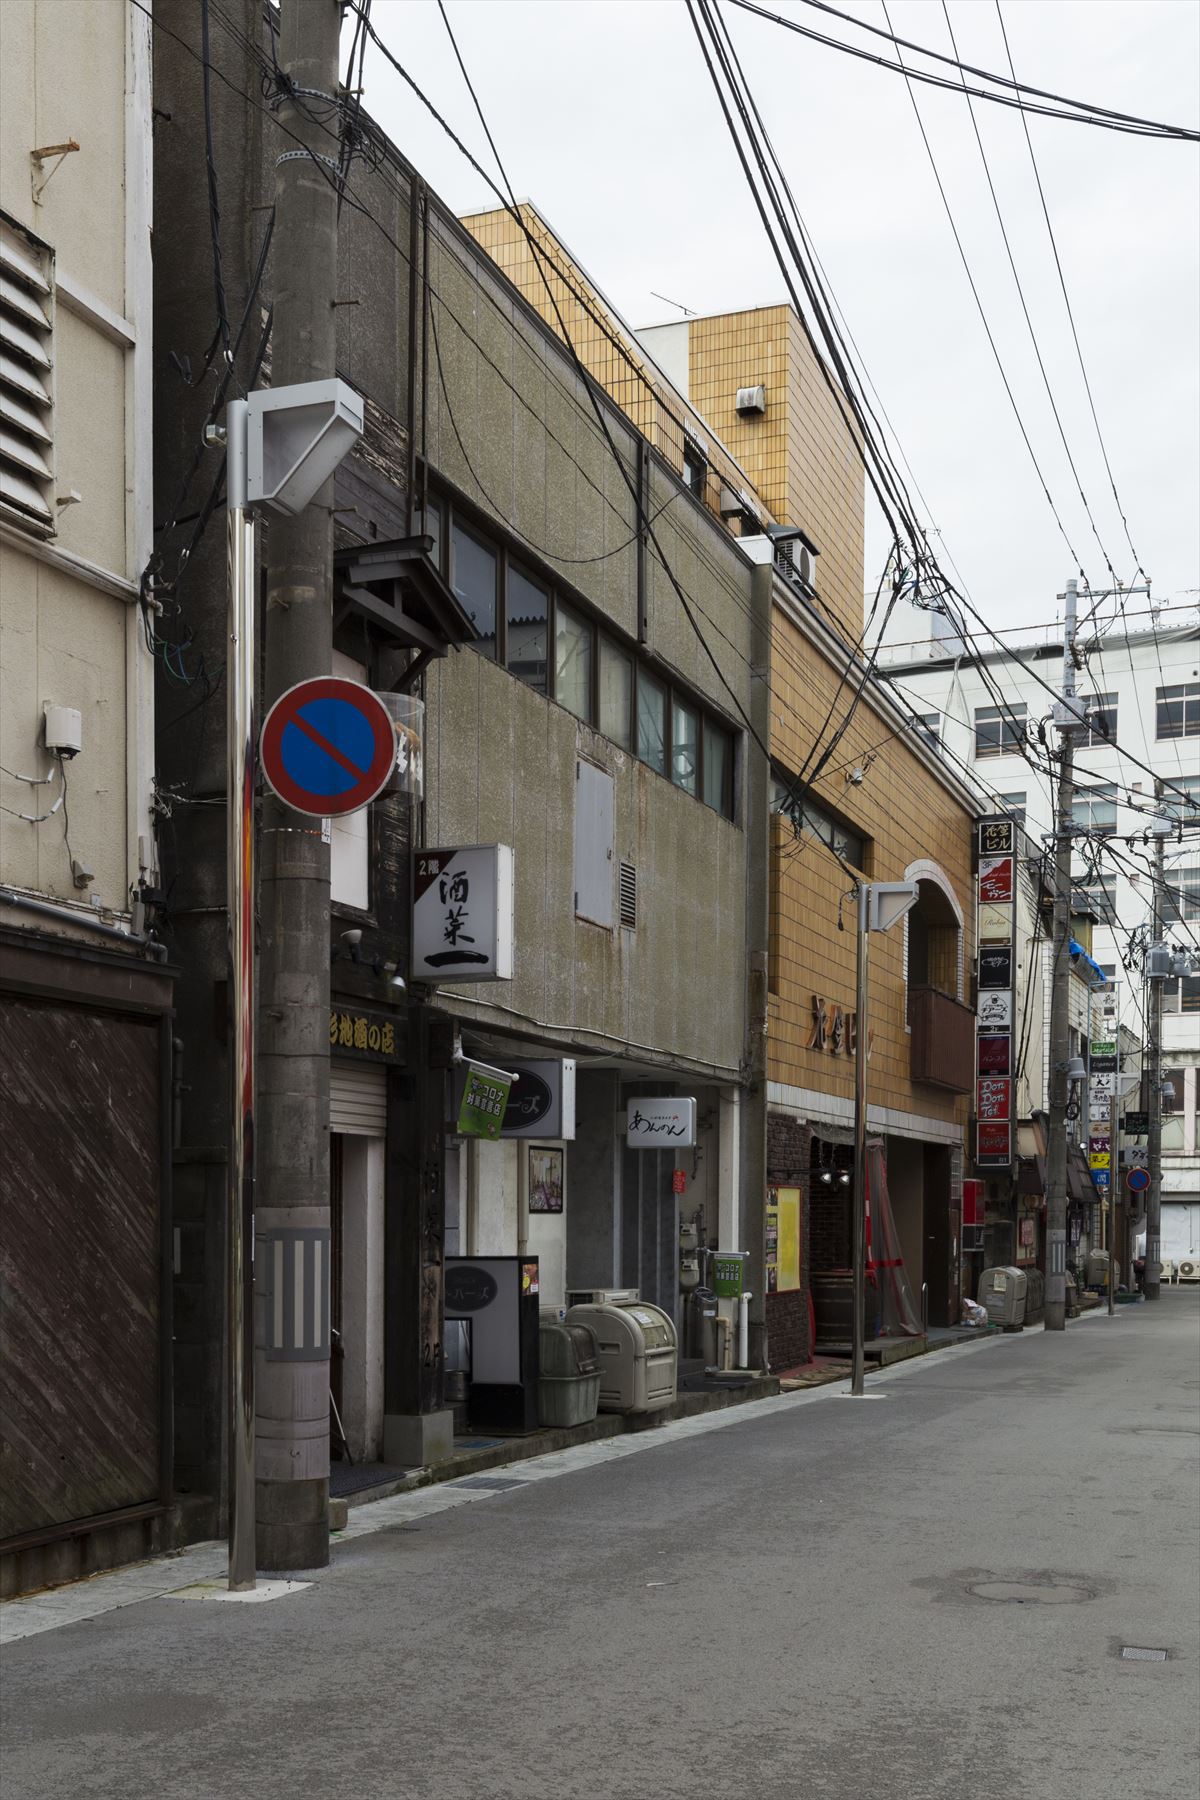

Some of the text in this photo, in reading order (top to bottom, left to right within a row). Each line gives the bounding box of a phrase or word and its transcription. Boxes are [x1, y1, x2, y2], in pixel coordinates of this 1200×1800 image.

[986, 837, 1011, 850] ビル
[420, 860, 440, 875] 2階
[982, 861, 993, 869] 3F
[483, 1085, 504, 1102] コロナ
